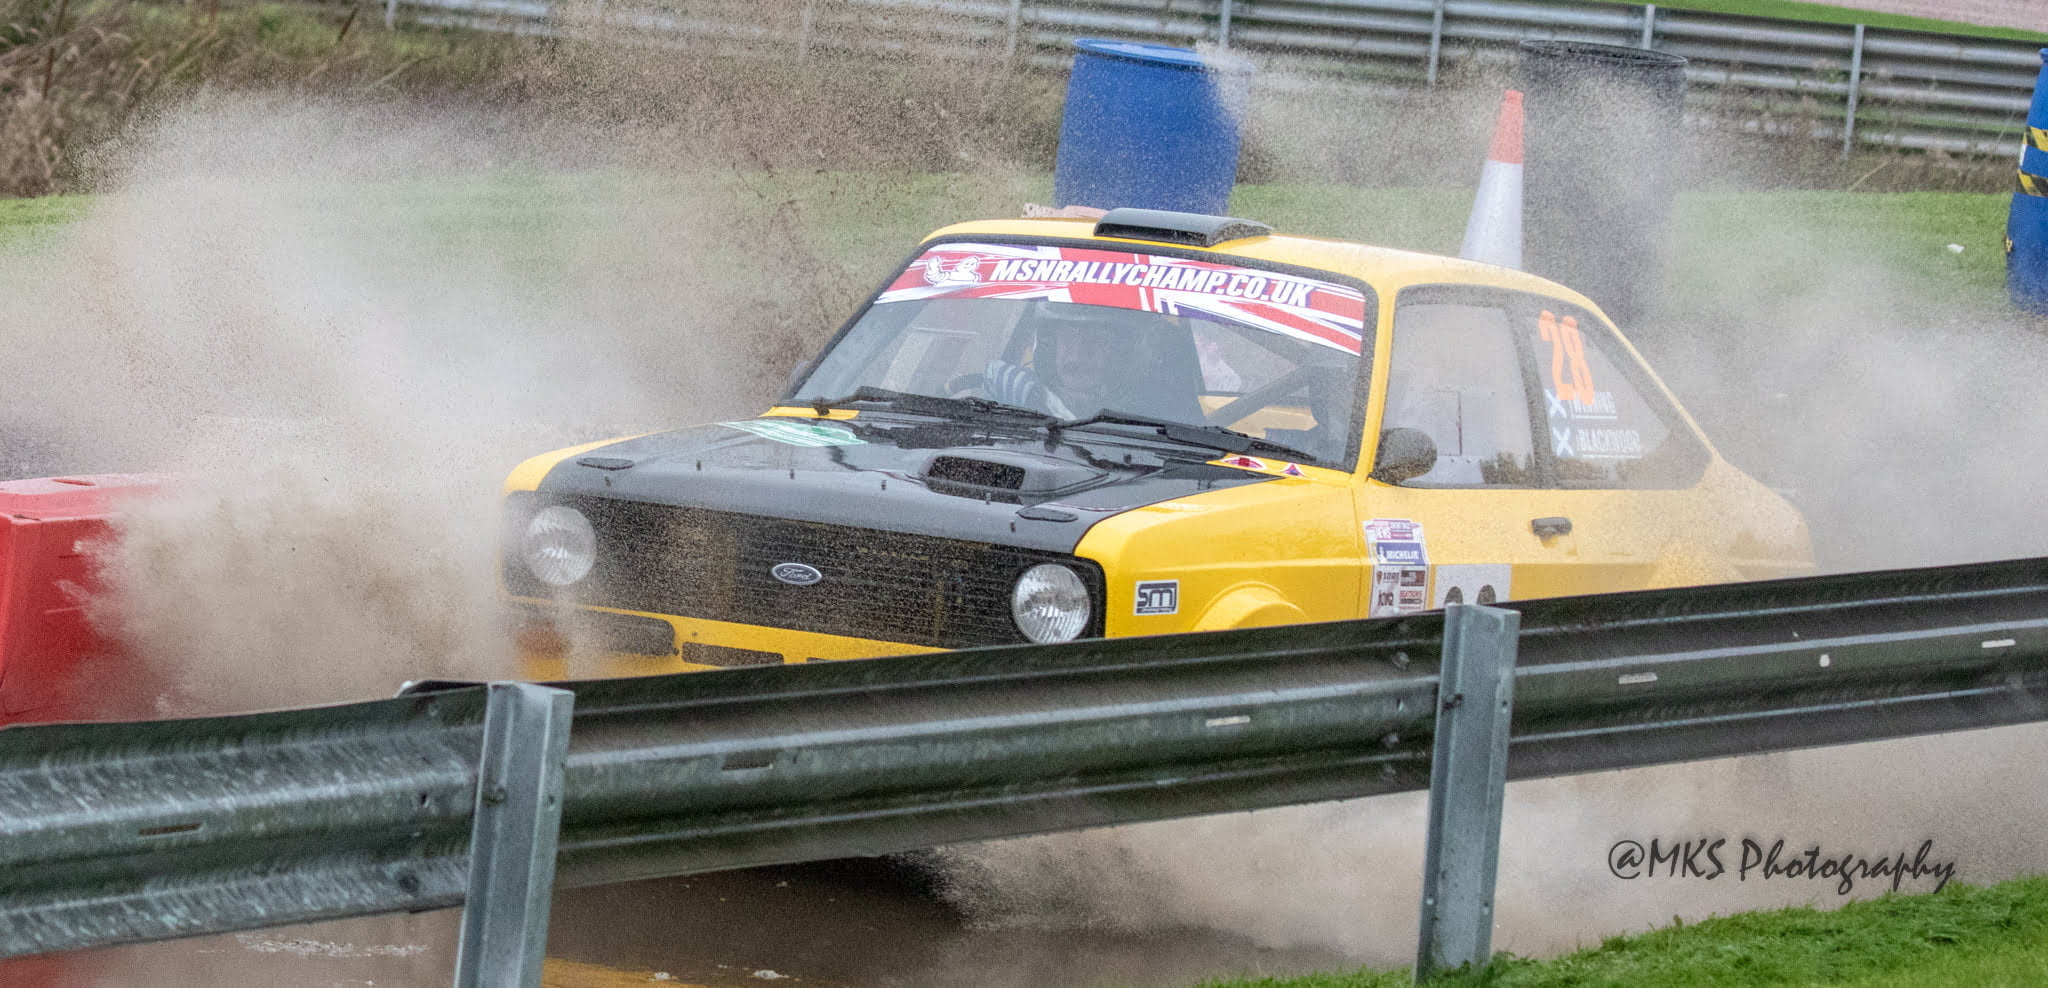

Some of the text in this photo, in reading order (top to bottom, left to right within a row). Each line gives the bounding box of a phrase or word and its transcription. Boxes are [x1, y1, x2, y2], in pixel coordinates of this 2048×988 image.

[989, 258, 1318, 307] MSNRALLYCHAMP.CO.UK
[1538, 310, 1594, 405] 28
[1578, 429, 1641, 452] BLACKWOOD
[1386, 550, 1420, 560] MICHELIN
